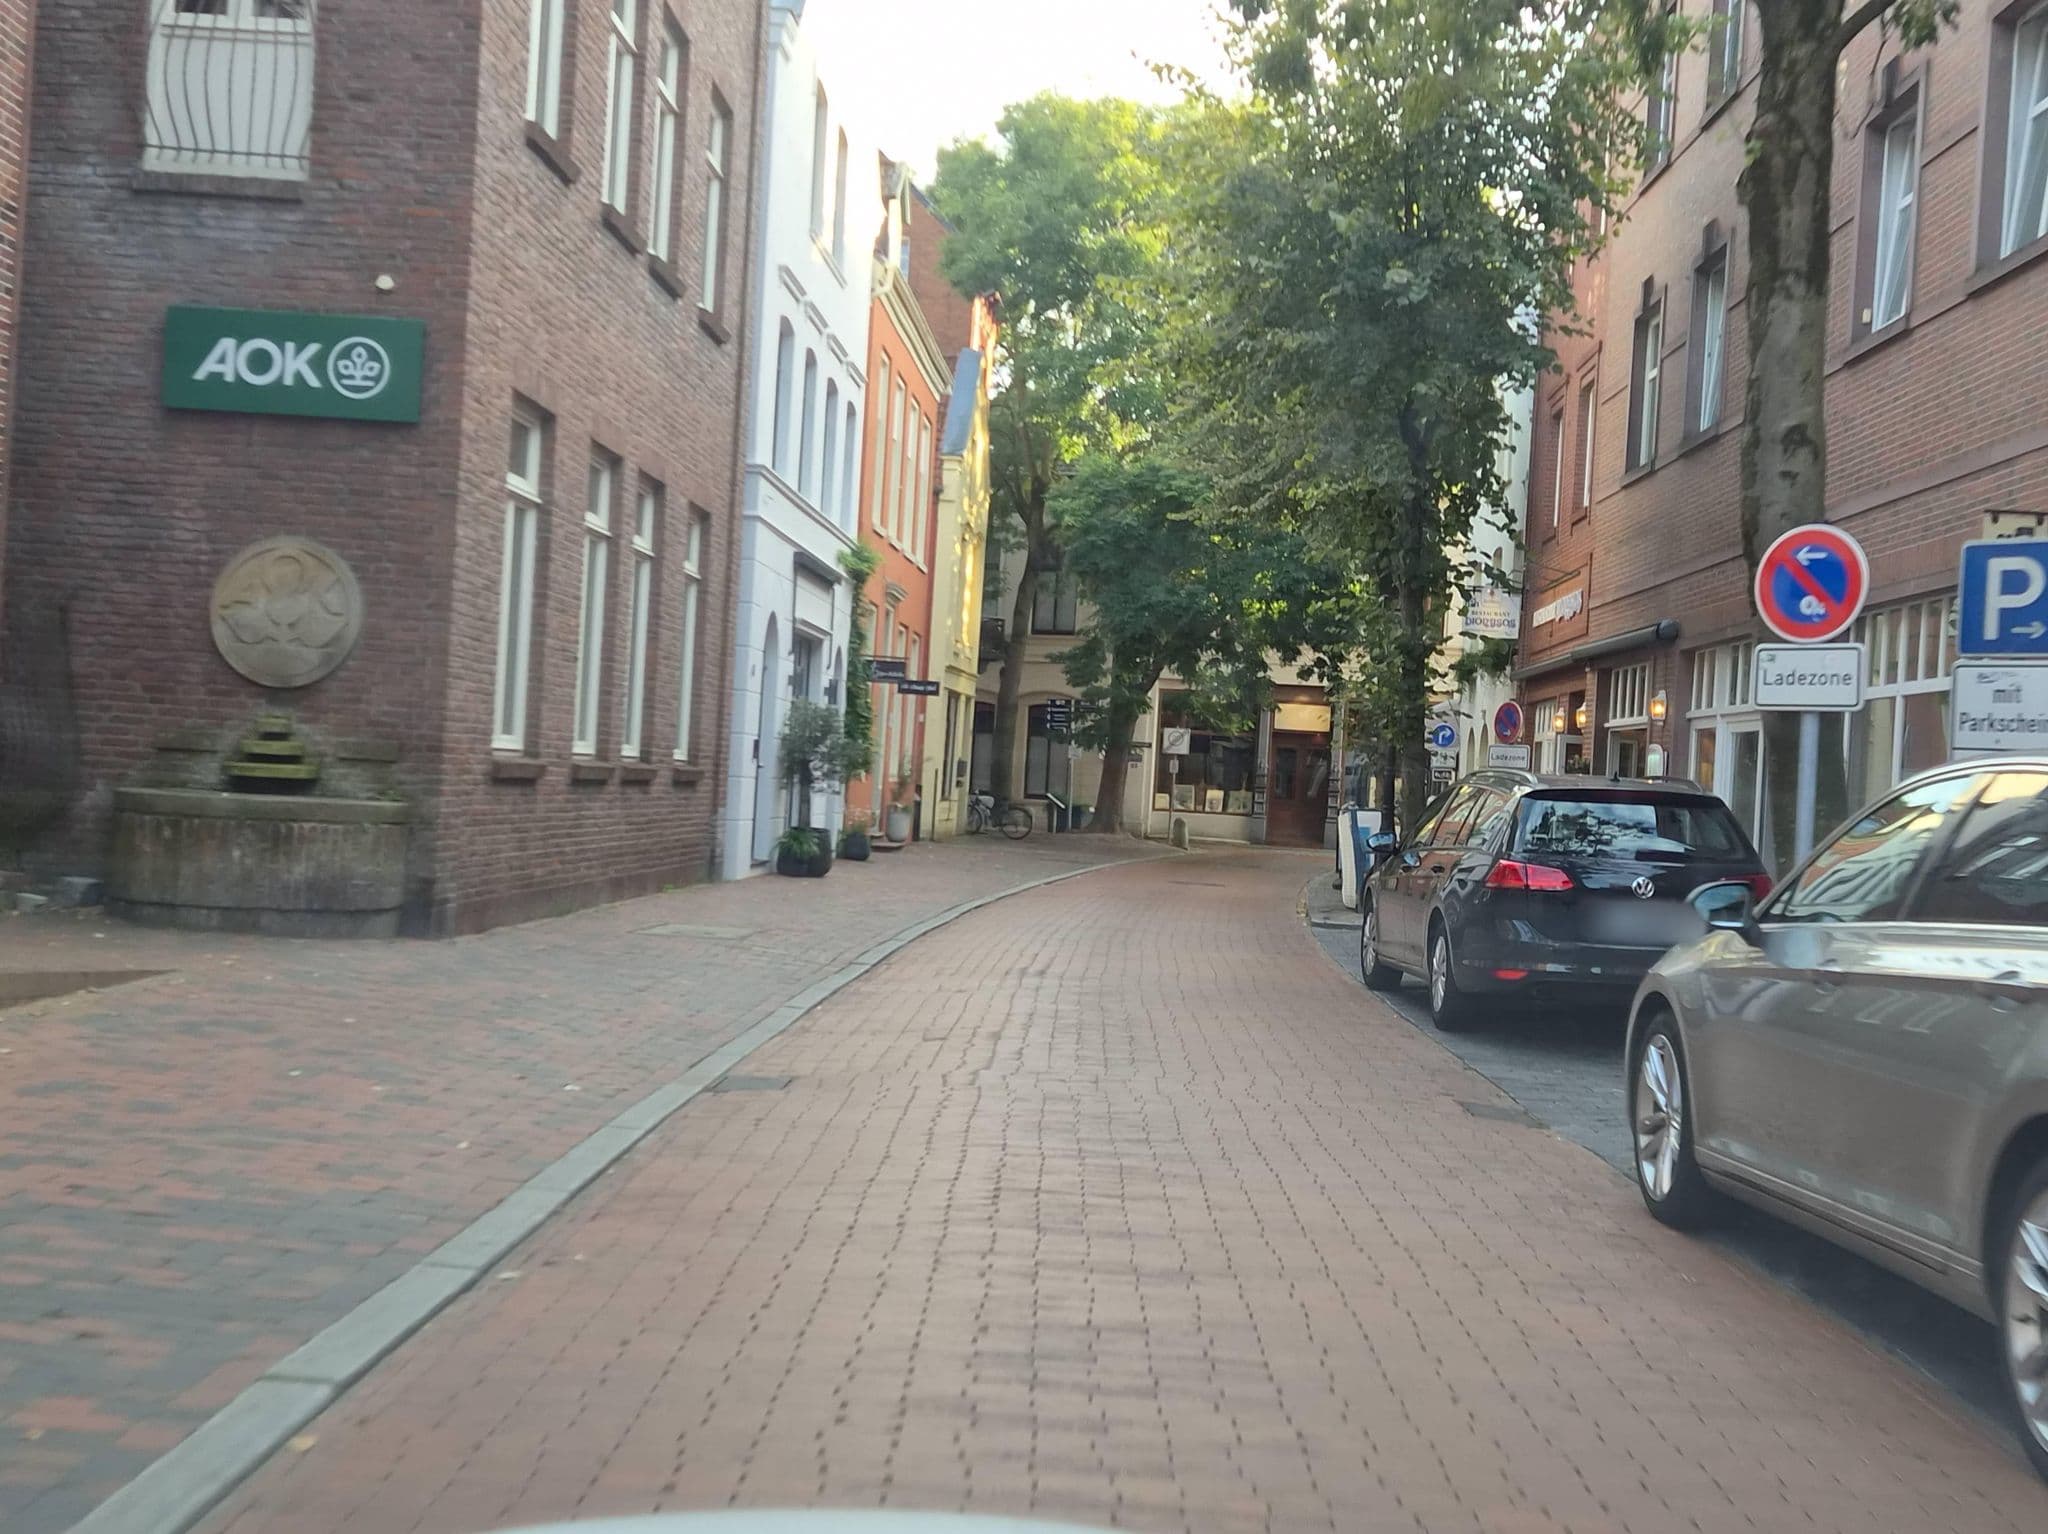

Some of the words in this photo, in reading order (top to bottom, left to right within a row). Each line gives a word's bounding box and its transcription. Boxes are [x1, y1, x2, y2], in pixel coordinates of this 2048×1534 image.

[192, 337, 323, 388] AOK
[1983, 556, 2046, 641] P
[1763, 668, 1853, 687] Ladezone
[1491, 753, 1526, 762] Ladezone
